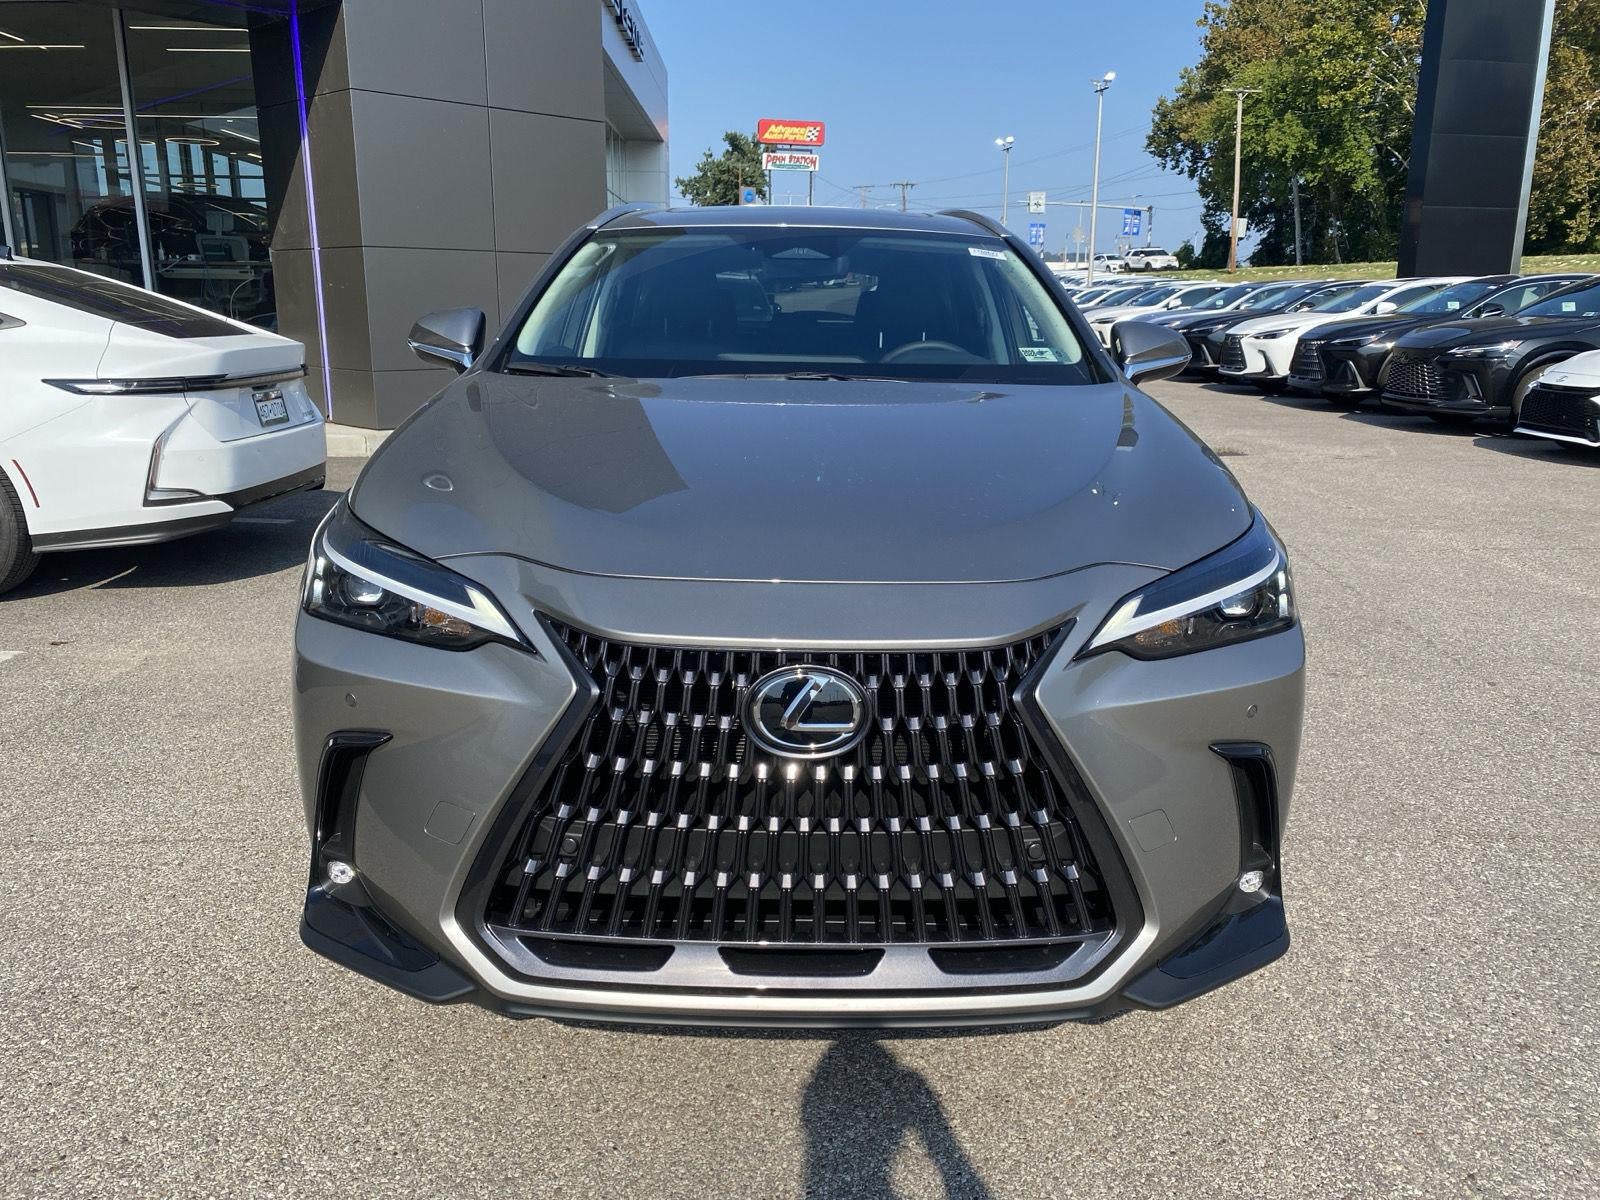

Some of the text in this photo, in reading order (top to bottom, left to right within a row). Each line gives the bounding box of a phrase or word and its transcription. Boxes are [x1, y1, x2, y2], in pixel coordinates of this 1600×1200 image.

[768, 125, 807, 133] Advance
[763, 132, 806, 141] Auto Parts
[766, 155, 787, 169] PENN
[789, 155, 817, 170] STATION
